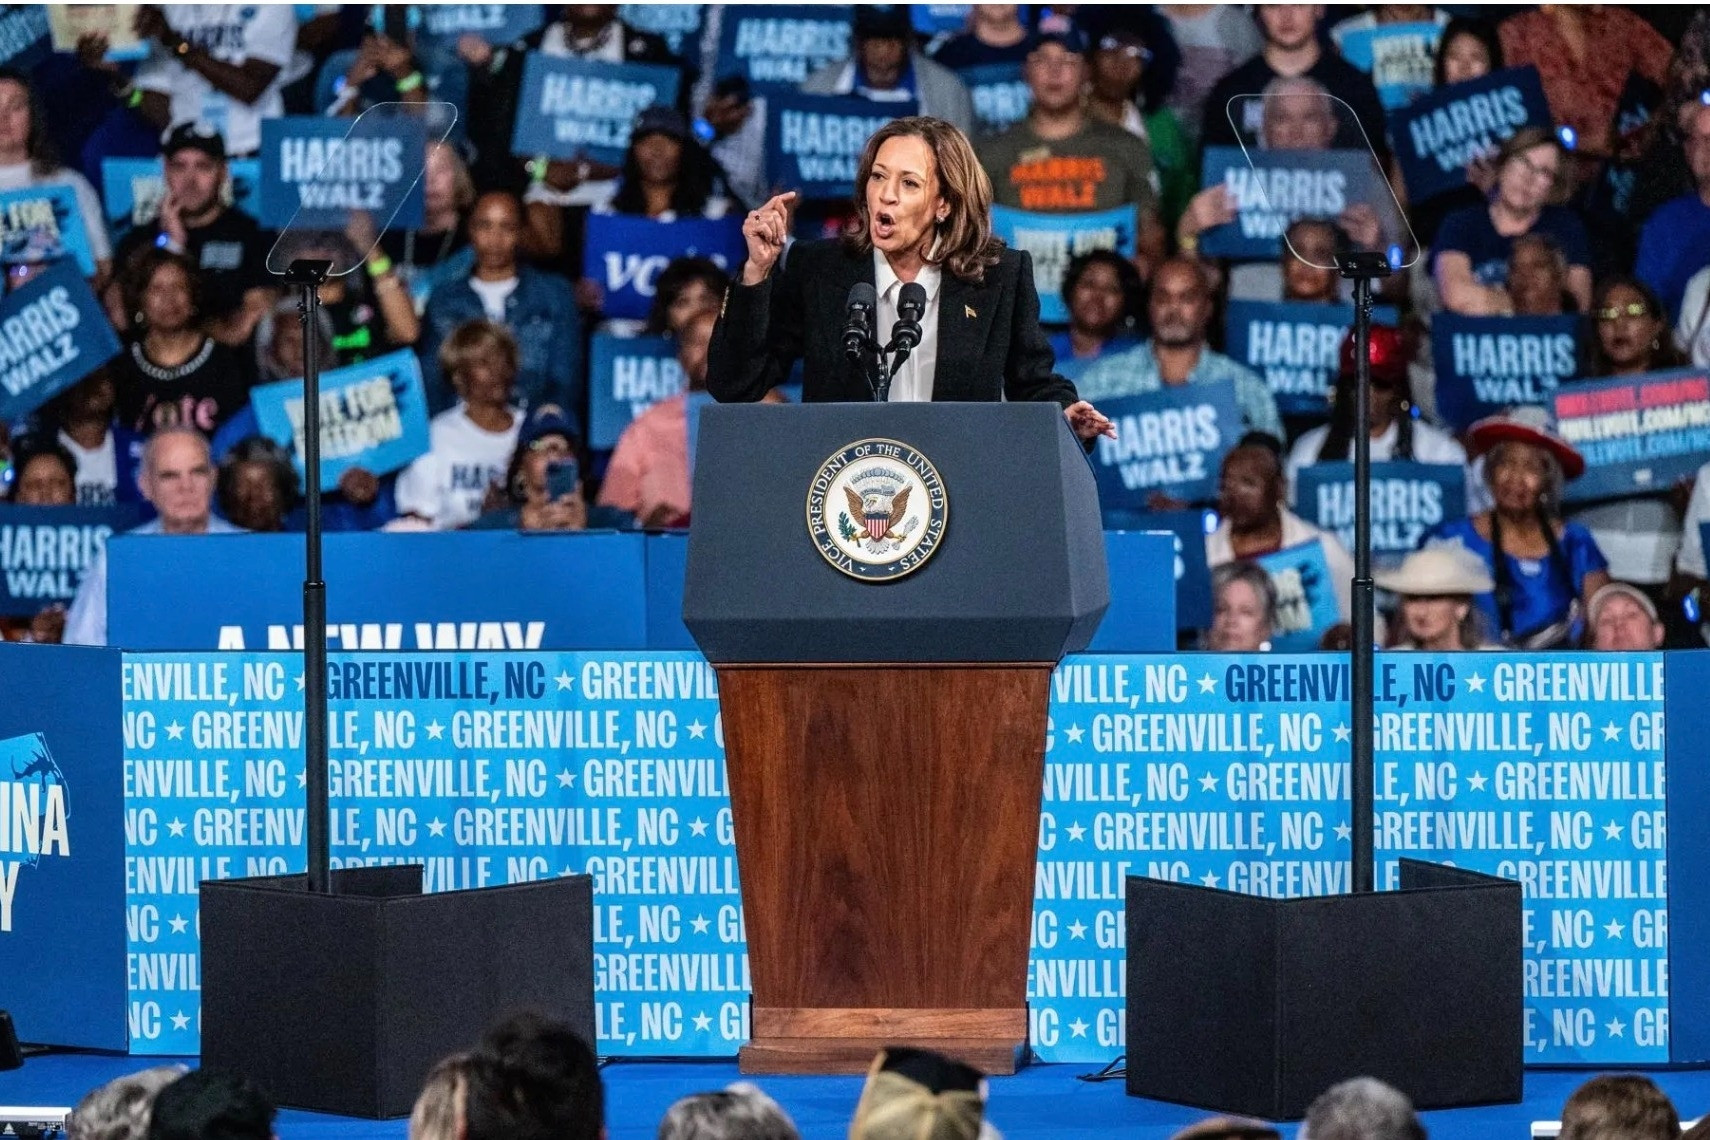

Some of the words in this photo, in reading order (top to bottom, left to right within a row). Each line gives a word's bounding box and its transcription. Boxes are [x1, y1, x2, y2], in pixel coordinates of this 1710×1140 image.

[782, 109, 888, 153] HARR
[1410, 85, 1529, 158] HARRIS
[280, 137, 403, 182] HARRIS
[299, 182, 385, 209] WALZ
[1225, 166, 1347, 215] HARRIS
[2, 332, 80, 396] WALZ
[1248, 320, 1349, 370] HARR
[1453, 333, 1576, 377] HARRIS
[613, 356, 689, 400] HAR
[855, 444, 871, 457] OF
[876, 444, 901, 458] THE
[1098, 404, 1220, 466] HARRIS
[906, 453, 944, 510] UNITED
[1120, 451, 1206, 490] WALZ
[810, 451, 849, 535] PRESIDENT
[822, 541, 853, 572] VICE
[901, 518, 942, 571] STATES
[7, 570, 85, 598] WAL
[268, 623, 403, 649] NW
[244, 662, 285, 700] NC
[327, 661, 500, 705] GREENVILLE,
[505, 661, 546, 699] NC
[1050, 664, 1141, 709] VILLE,
[1145, 664, 1188, 702] NC
[1225, 663, 1408, 708] GREENVIE,
[1413, 663, 1456, 701] NC
[192, 711, 370, 755] GREENVLE,
[375, 710, 416, 749] NC
[452, 711, 632, 755] GREENVILLE,
[636, 711, 677, 748] NC
[1092, 712, 1276, 758] GREENVILLE,
[1280, 712, 1322, 751] NC
[1549, 712, 1592, 751] NC
[246, 759, 286, 798] NC
[328, 759, 501, 803] GREENVILLE,
[506, 759, 547, 797] NC
[1147, 762, 1189, 801] NC
[1415, 762, 1457, 800] NC
[194, 808, 371, 852] GREENVLE,
[376, 808, 417, 846] NC
[454, 808, 633, 851] GREENVILLE,
[638, 808, 679, 846] NC
[1094, 812, 1276, 856] GREENVILLE,
[1281, 812, 1323, 850] NC
[1550, 811, 1593, 850] NC
[640, 905, 681, 943] NC
[1551, 909, 1594, 948] NC
[641, 1002, 683, 1041] NC
[1553, 1007, 1595, 1047] NC
